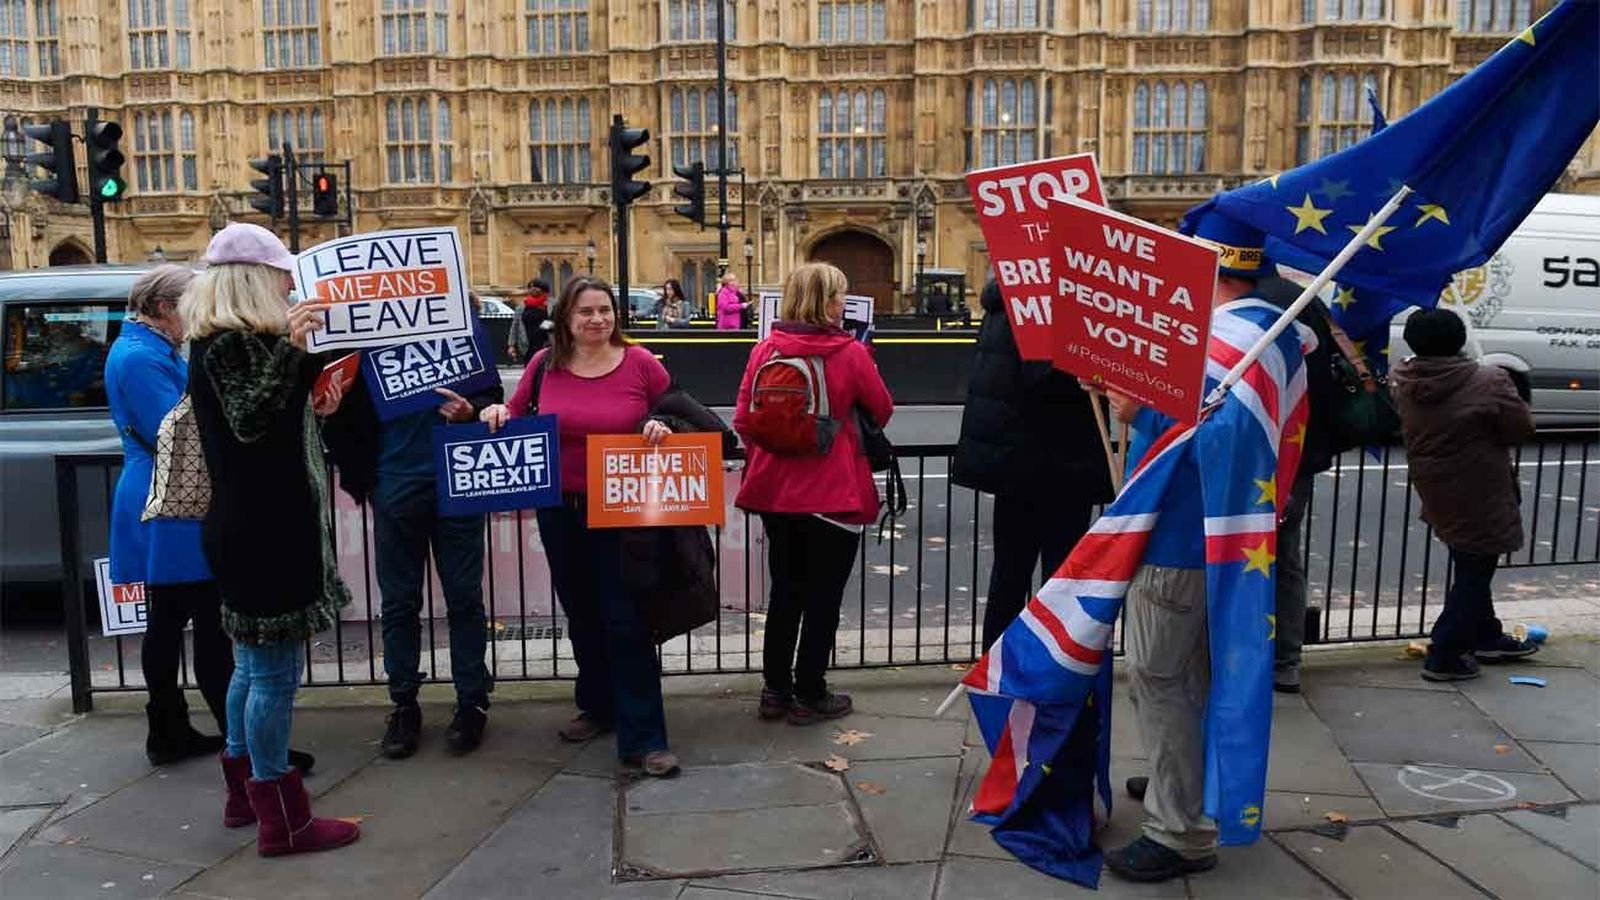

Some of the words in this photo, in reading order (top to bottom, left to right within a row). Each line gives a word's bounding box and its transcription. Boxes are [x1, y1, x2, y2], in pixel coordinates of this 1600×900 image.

[978, 169, 1090, 216] STOP
[313, 237, 442, 278] LEAVE
[1103, 224, 1156, 262] WE
[327, 271, 436, 301] MEANS
[1064, 246, 1164, 297] WANT
[1169, 286, 1193, 311] A
[325, 296, 449, 335] LEAVE
[1059, 276, 1199, 346] PEOPLE'S
[377, 337, 471, 374] SAVE
[1083, 316, 1168, 367] VOTE
[385, 354, 473, 394] BREXIT
[1065, 344, 1184, 399] #PeoplesVote
[452, 437, 544, 471] SAVE
[606, 453, 682, 475] BELIEVE
[688, 453, 705, 473] IN
[455, 464, 545, 491] BREXIT
[606, 476, 706, 504] BRITAIN
